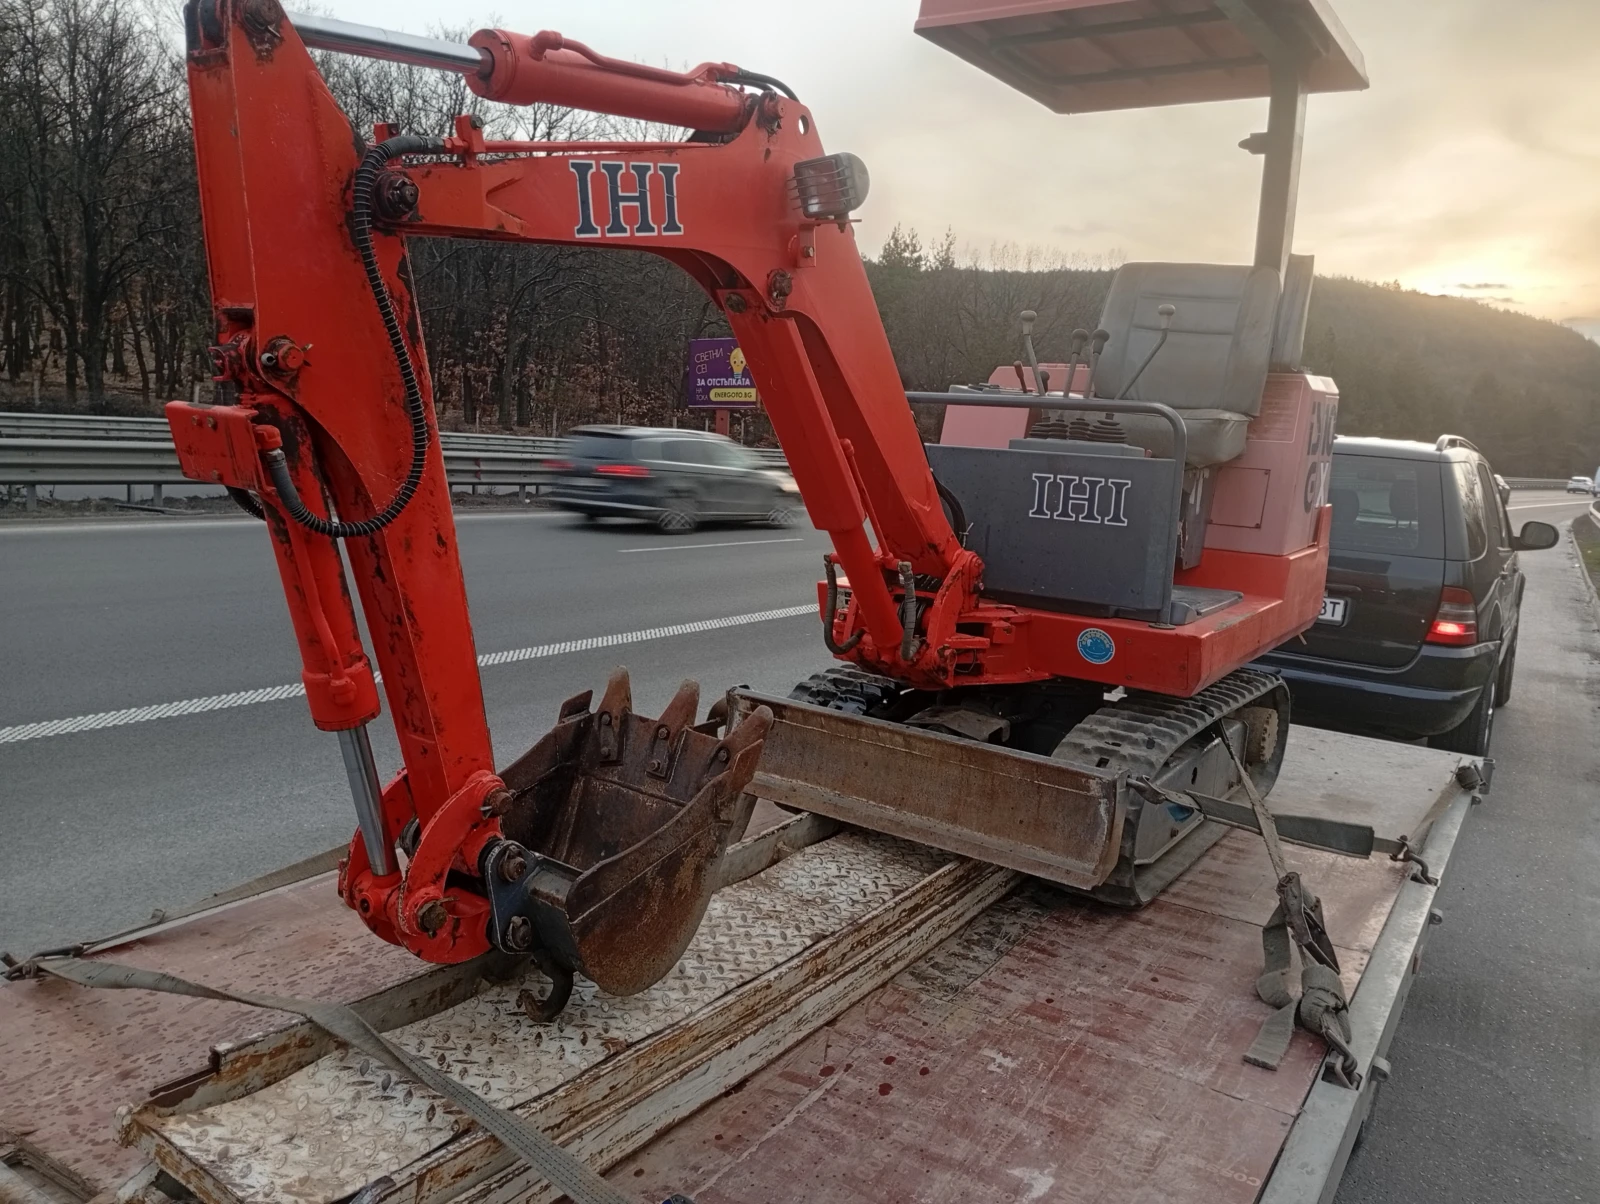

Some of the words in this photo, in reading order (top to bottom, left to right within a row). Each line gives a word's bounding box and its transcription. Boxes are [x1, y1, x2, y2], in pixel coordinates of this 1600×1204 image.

[569, 160, 684, 238] IHI
[694, 348, 724, 363] СВЕТНИ
[1029, 473, 1131, 526] IHI
